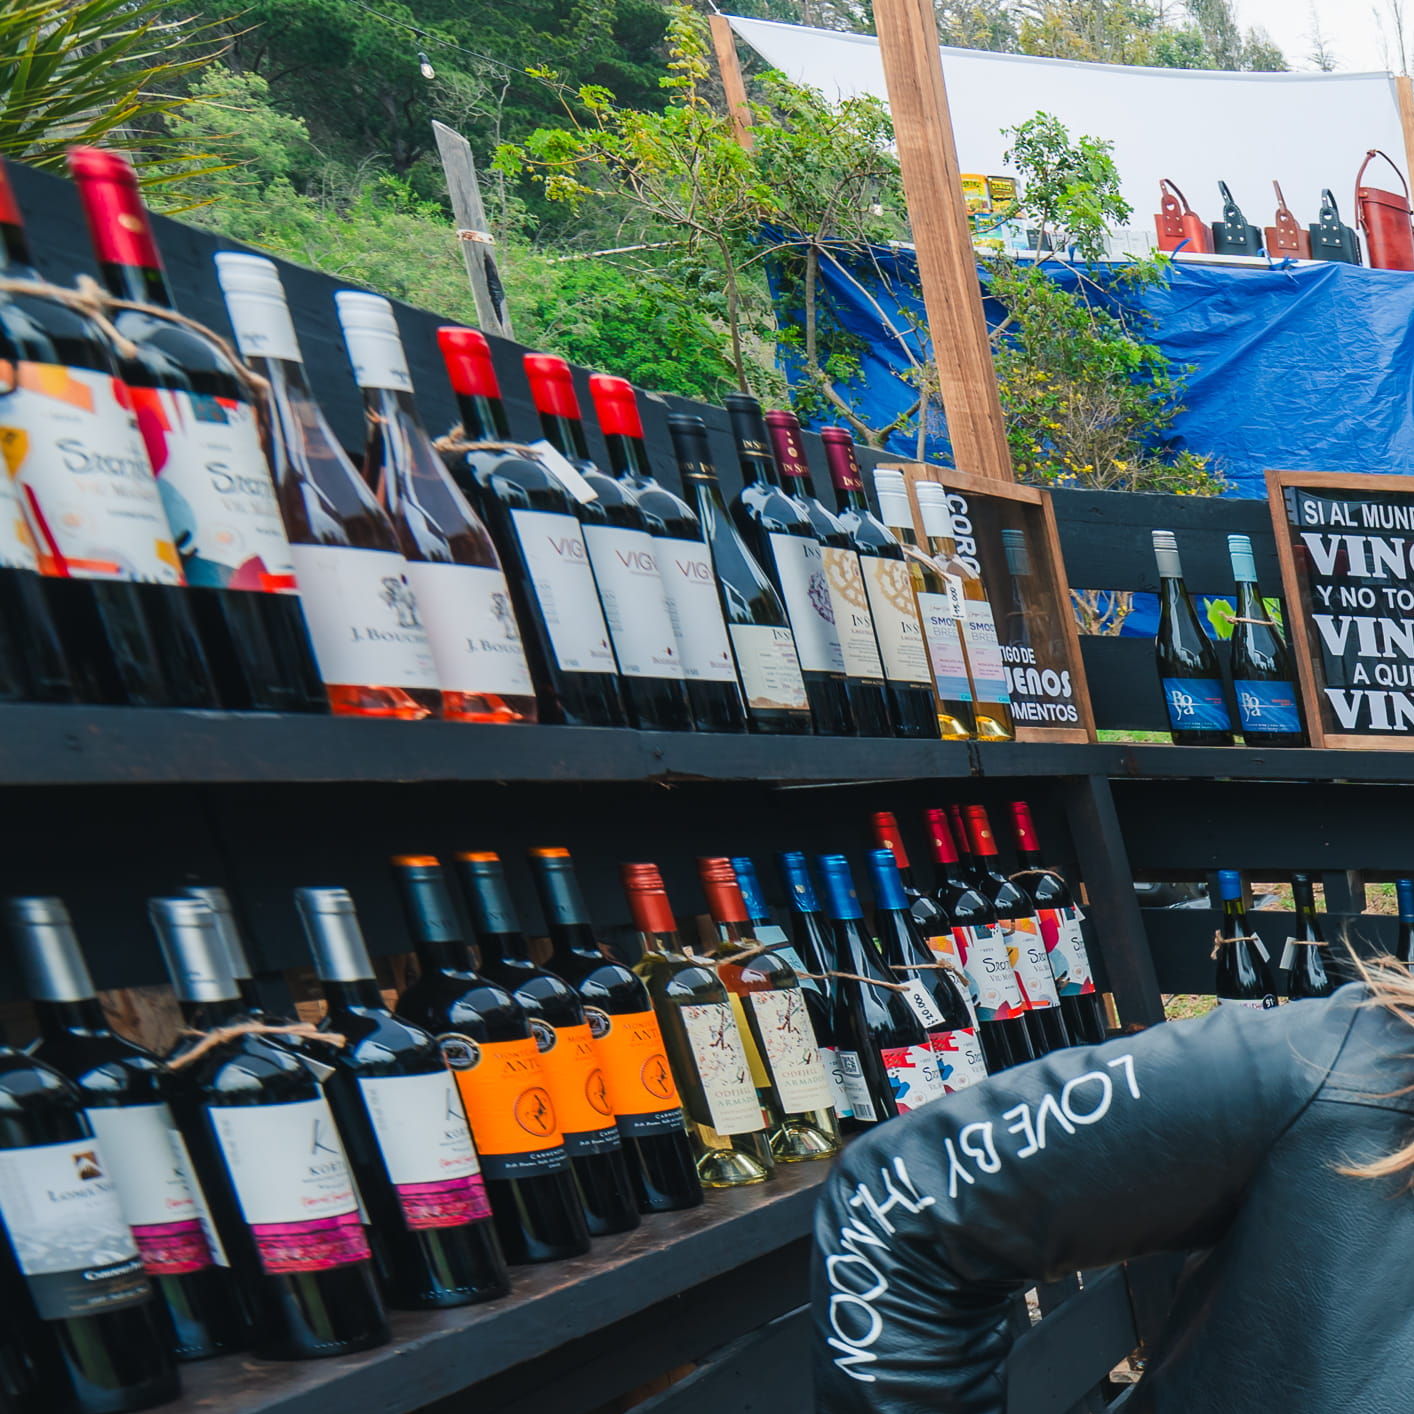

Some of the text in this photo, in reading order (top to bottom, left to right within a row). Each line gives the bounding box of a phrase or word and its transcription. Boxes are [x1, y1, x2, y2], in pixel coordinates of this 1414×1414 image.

[1304, 500, 1325, 526] SI
[1330, 502, 1358, 528] AL
[1316, 585, 1333, 606] Y
[1340, 587, 1376, 609] NO
[1021, 647, 1036, 665] DE
[1353, 663, 1370, 685] A
[1003, 1054, 1141, 1159] LOVE
[945, 1121, 1001, 1198] BY
